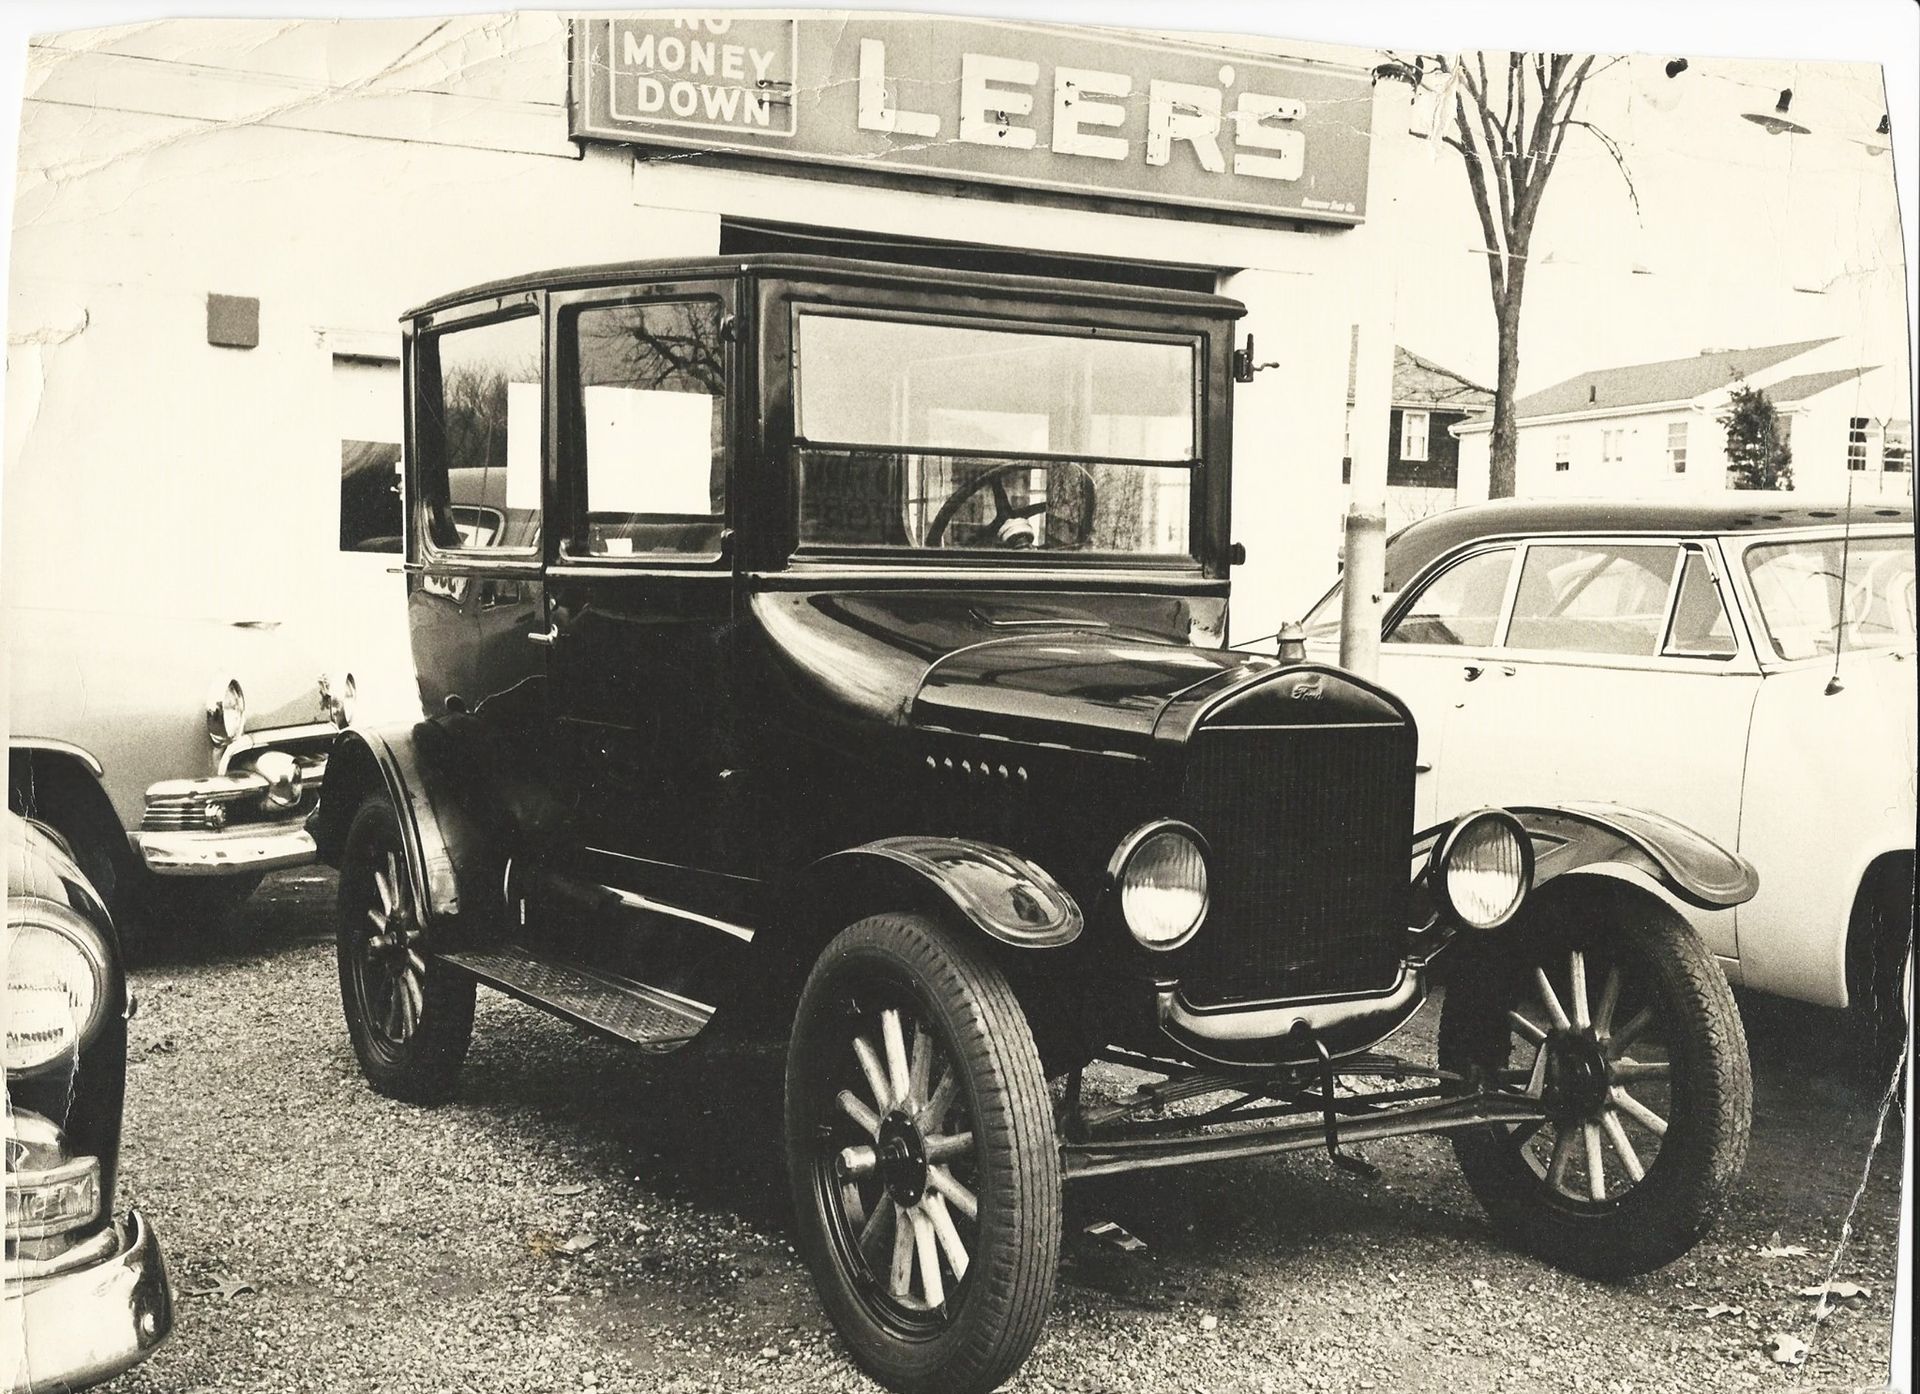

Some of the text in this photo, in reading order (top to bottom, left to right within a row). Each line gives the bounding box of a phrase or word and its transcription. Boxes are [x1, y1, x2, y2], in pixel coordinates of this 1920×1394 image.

[624, 31, 775, 80] MONEY
[638, 78, 770, 126] DOWN
[858, 38, 1306, 182] LEER'S
[1292, 683, 1326, 702] Ford
